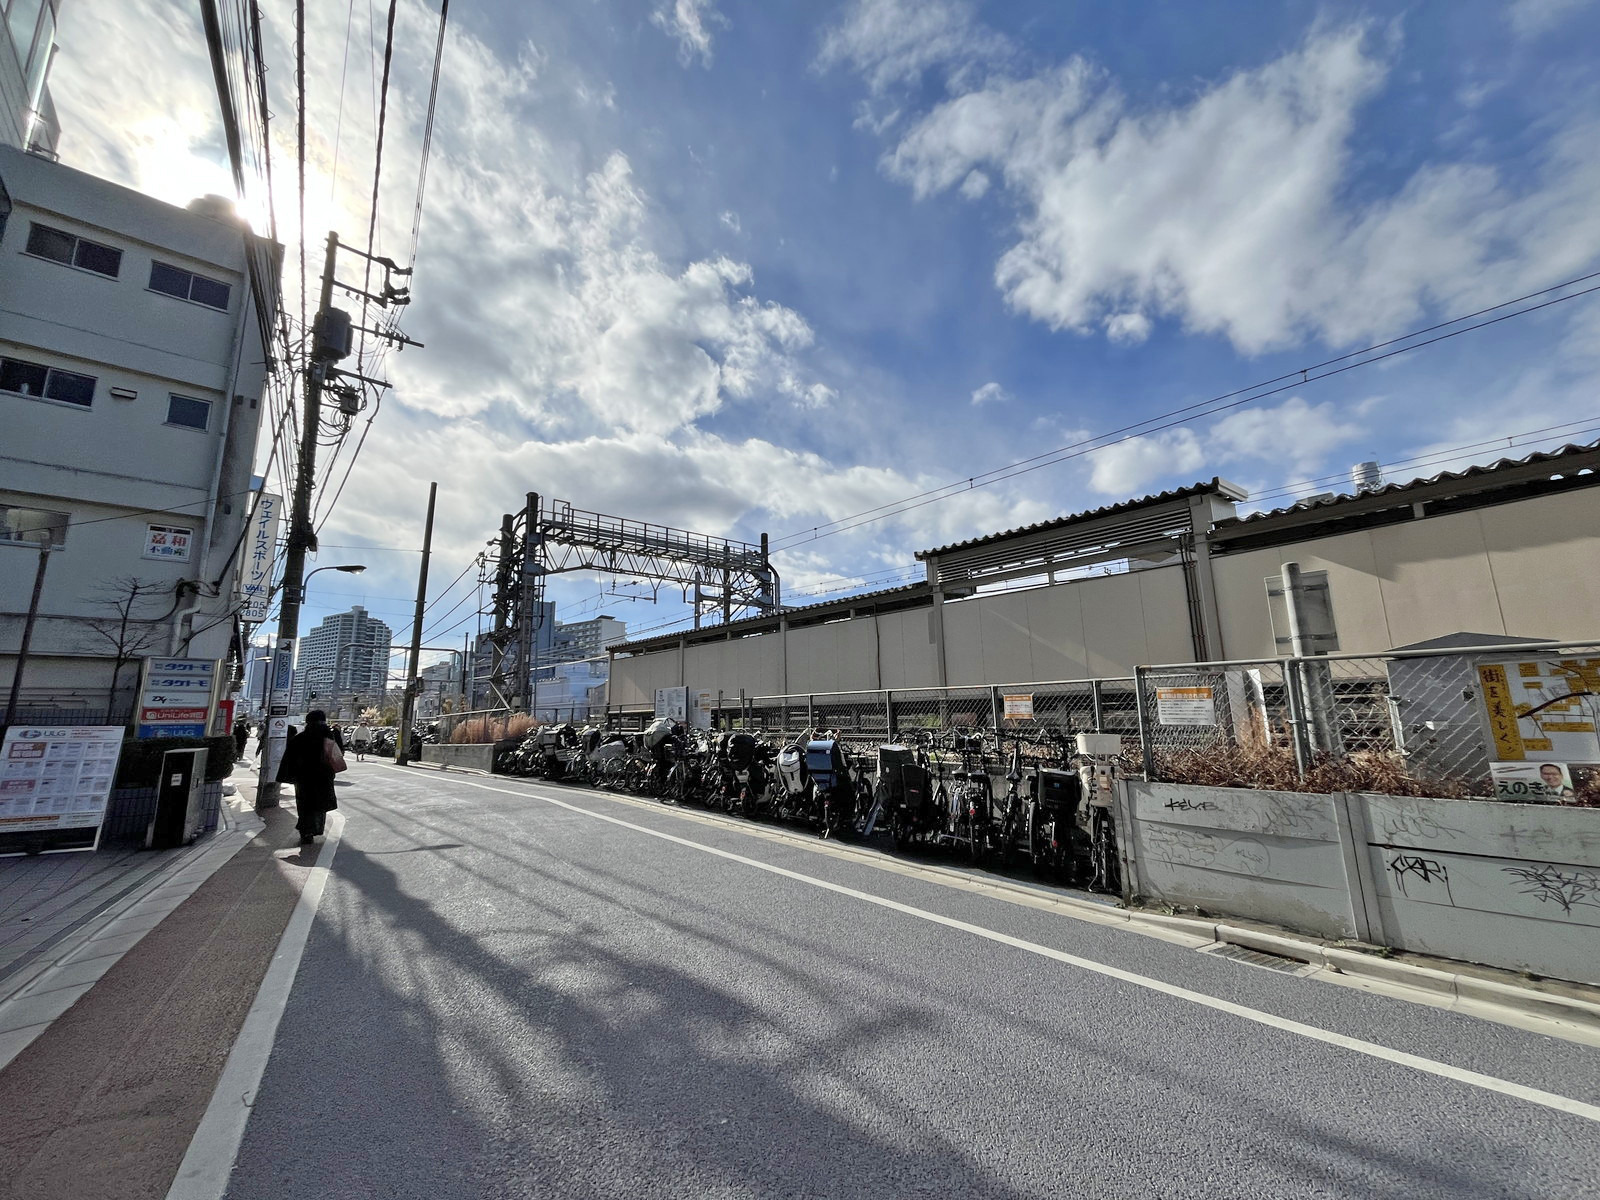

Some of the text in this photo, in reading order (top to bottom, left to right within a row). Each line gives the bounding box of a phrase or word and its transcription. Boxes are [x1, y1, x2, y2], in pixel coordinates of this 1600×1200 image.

[245, 584, 265, 592] VAIL
[1498, 781, 1544, 796] えのき
